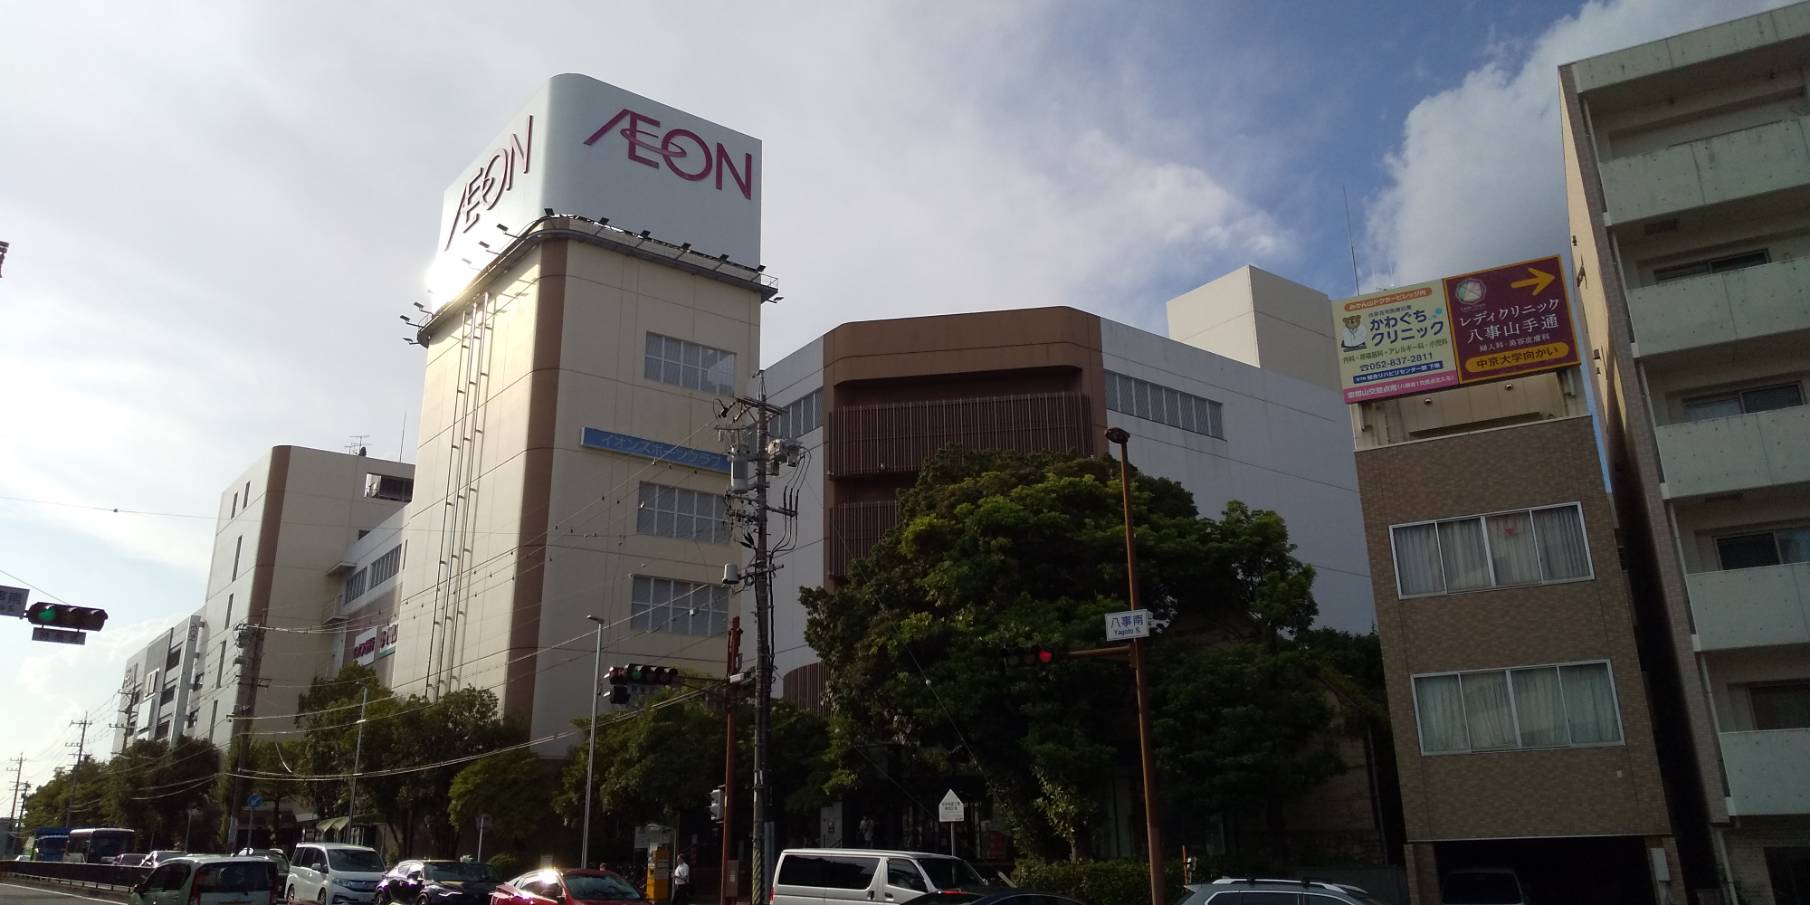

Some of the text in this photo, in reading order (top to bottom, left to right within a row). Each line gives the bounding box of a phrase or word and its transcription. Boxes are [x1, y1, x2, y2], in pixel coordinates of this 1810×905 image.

[1369, 310, 1428, 332] かわぐち
[1459, 298, 1560, 328] レディクリニック
[1371, 320, 1444, 346] クリニック
[1466, 313, 1561, 345] 八事山手通
[1368, 352, 1434, 370] 052-837-2811
[1476, 347, 1559, 369] 中京大学向かい
[1110, 614, 1144, 628] 八事南
